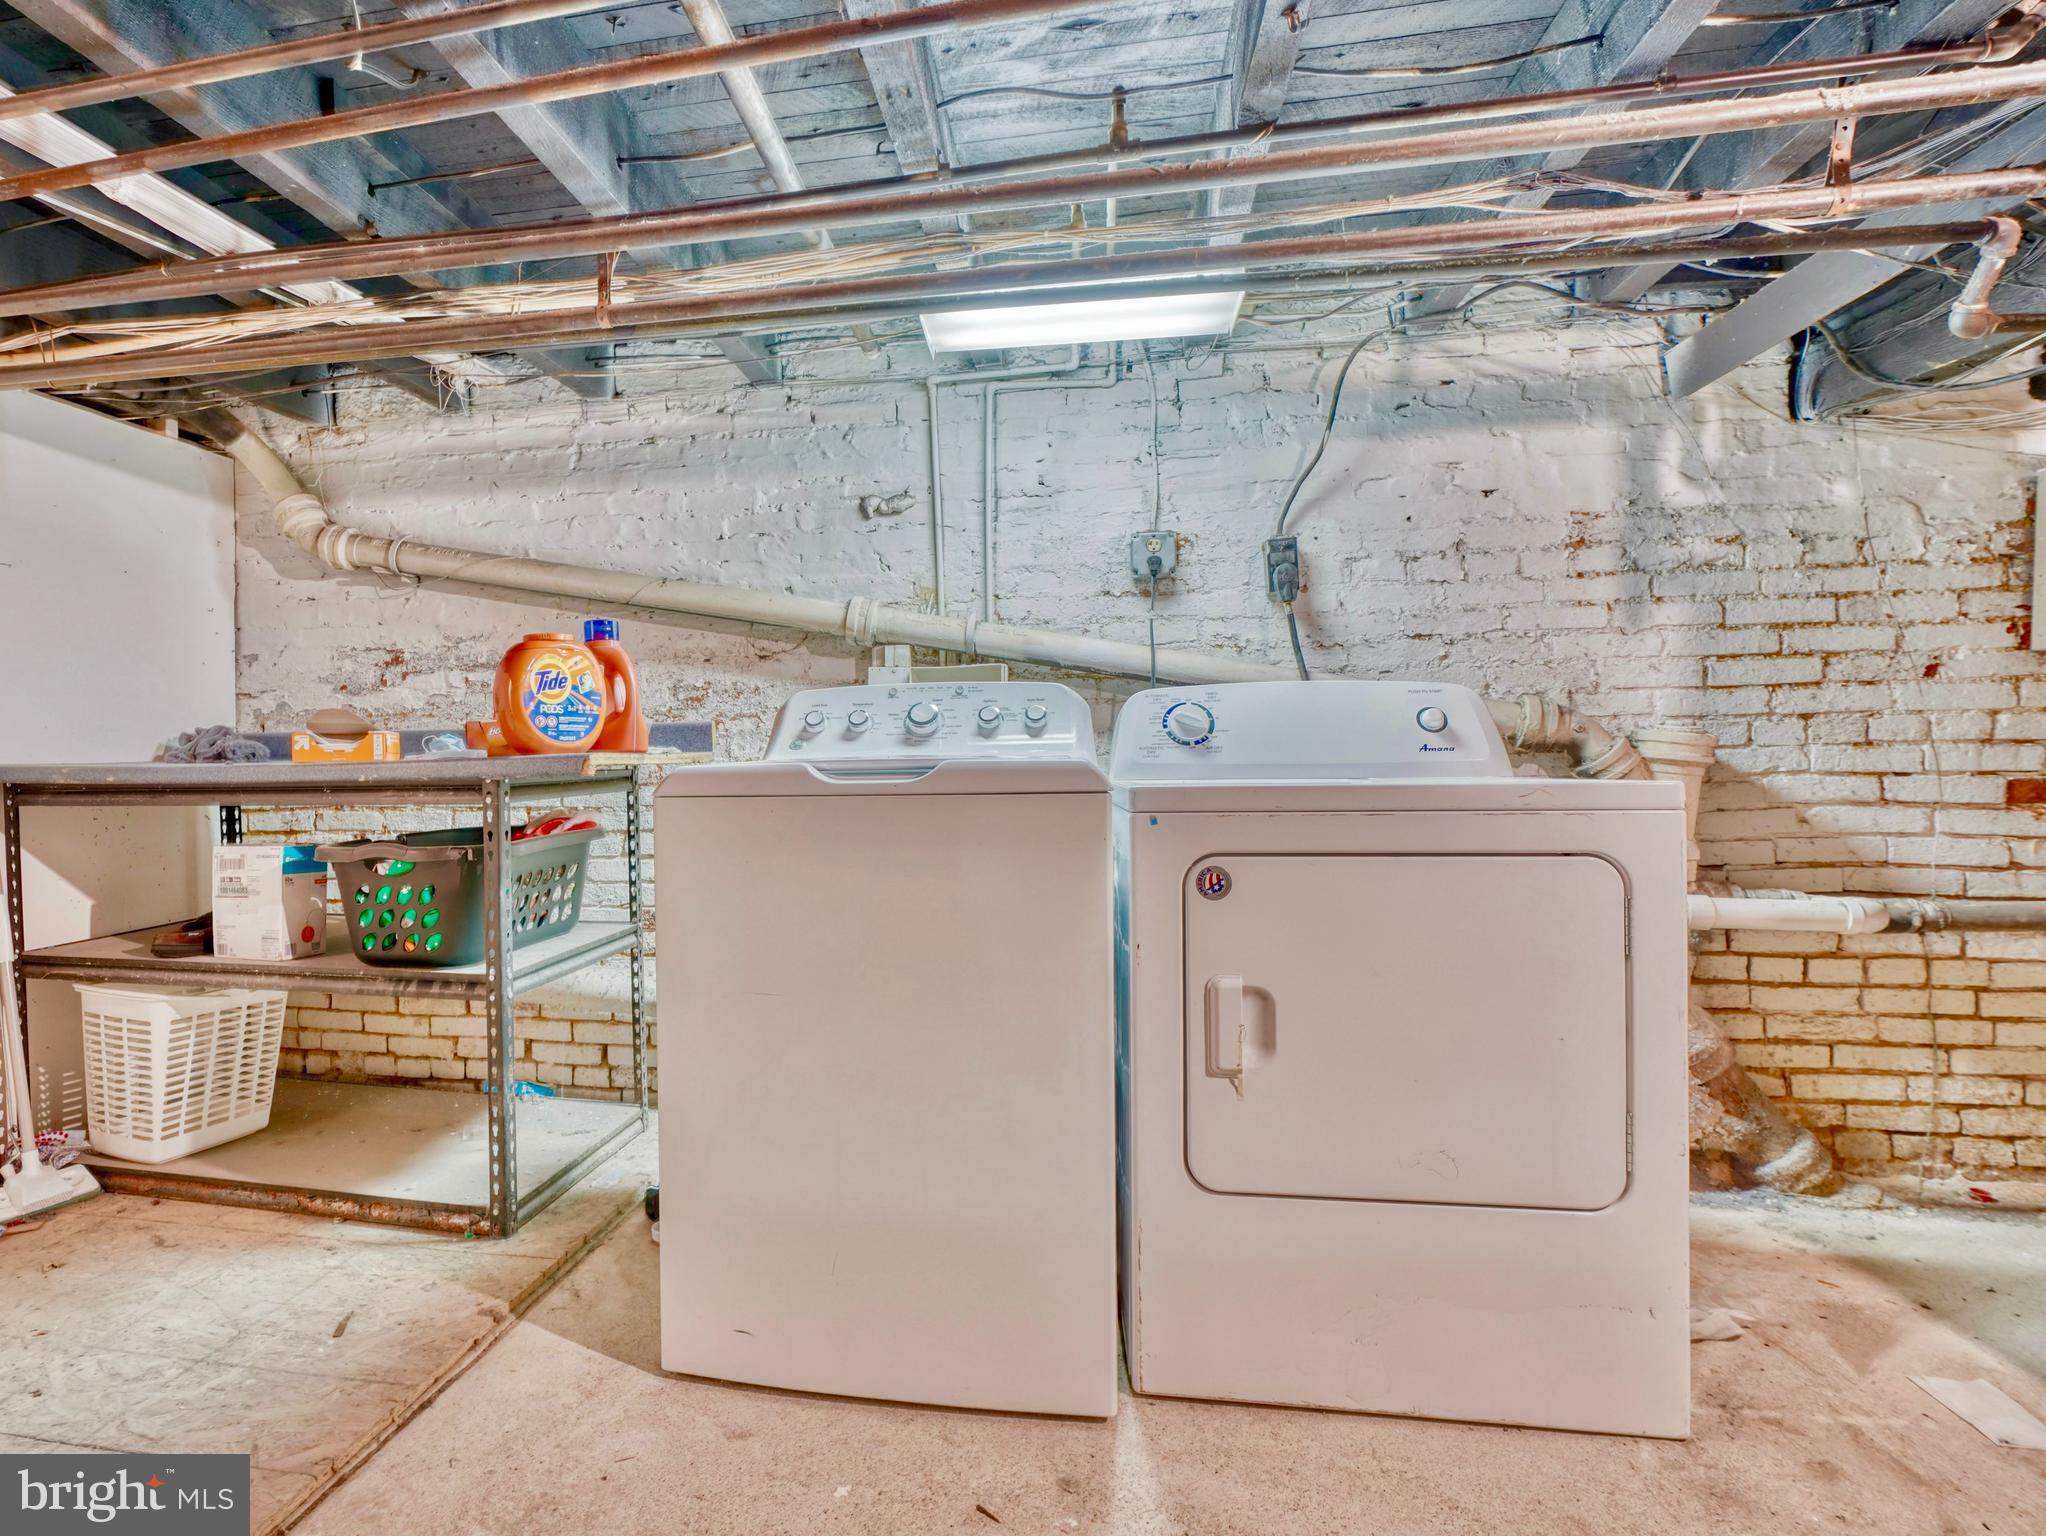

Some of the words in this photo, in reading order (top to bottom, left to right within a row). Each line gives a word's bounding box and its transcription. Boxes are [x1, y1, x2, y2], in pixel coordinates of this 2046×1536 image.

[535, 670, 568, 695] Tide
[540, 704, 564, 713] PODS
[1419, 744, 1455, 752] Amana
